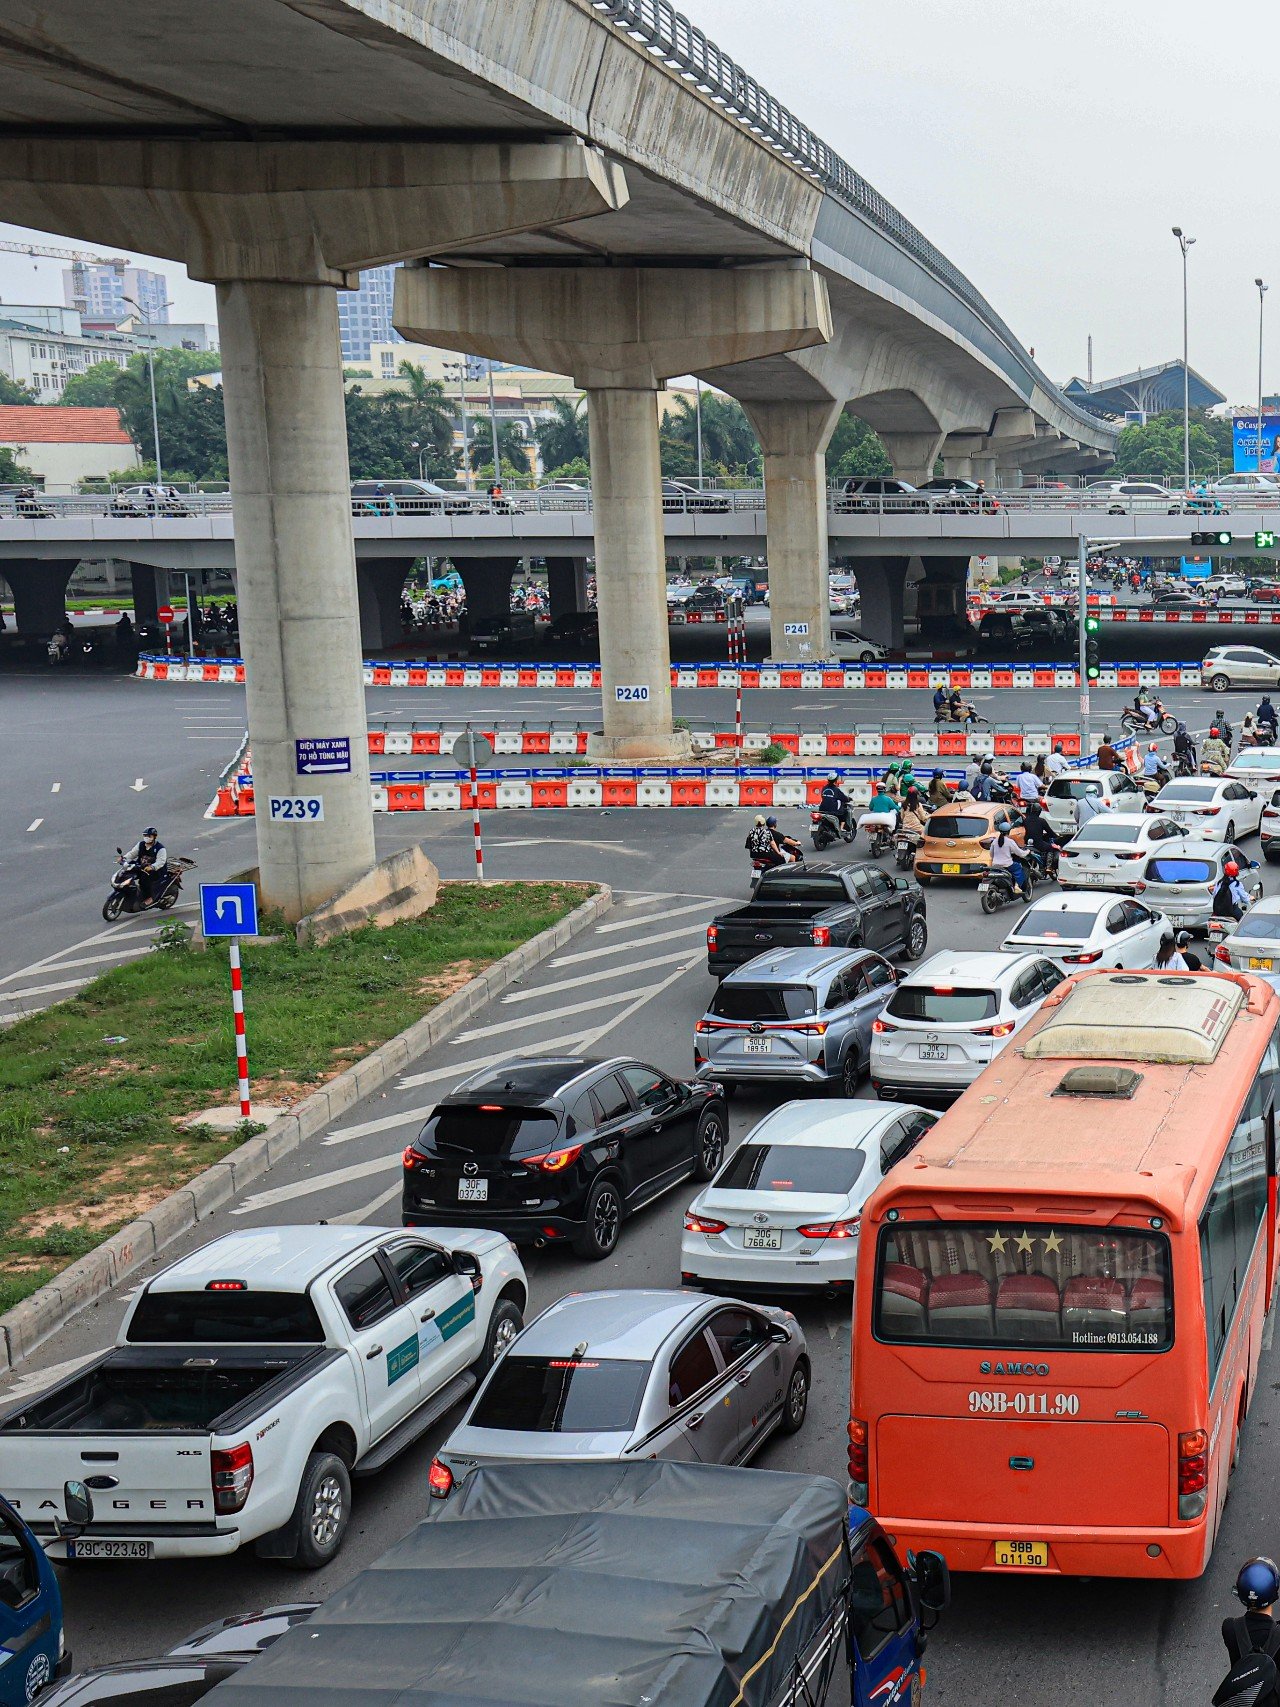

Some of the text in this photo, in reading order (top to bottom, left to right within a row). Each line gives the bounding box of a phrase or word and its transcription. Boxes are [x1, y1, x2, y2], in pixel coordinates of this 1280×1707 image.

[1257, 532, 1274, 547] 34
[785, 624, 808, 634] P241
[616, 687, 648, 700] P240
[316, 741, 330, 750] MÁY
[331, 740, 347, 749] XANH
[270, 799, 321, 818] P239
[465, 1179, 481, 1189] 30F
[459, 1189, 487, 1200] 037.33
[754, 1229, 772, 1238] 30G
[748, 1238, 777, 1248] 768.46
[1072, 1332, 1158, 1344] Hotline: 0913.054.188
[980, 1360, 1049, 1376] SAMCO
[968, 1390, 1080, 1415] 98B-011.90
[77, 1541, 147, 1557] 29C-923.48
[1009, 1542, 1033, 1553] 98B
[1000, 1552, 1042, 1565] 011.90
